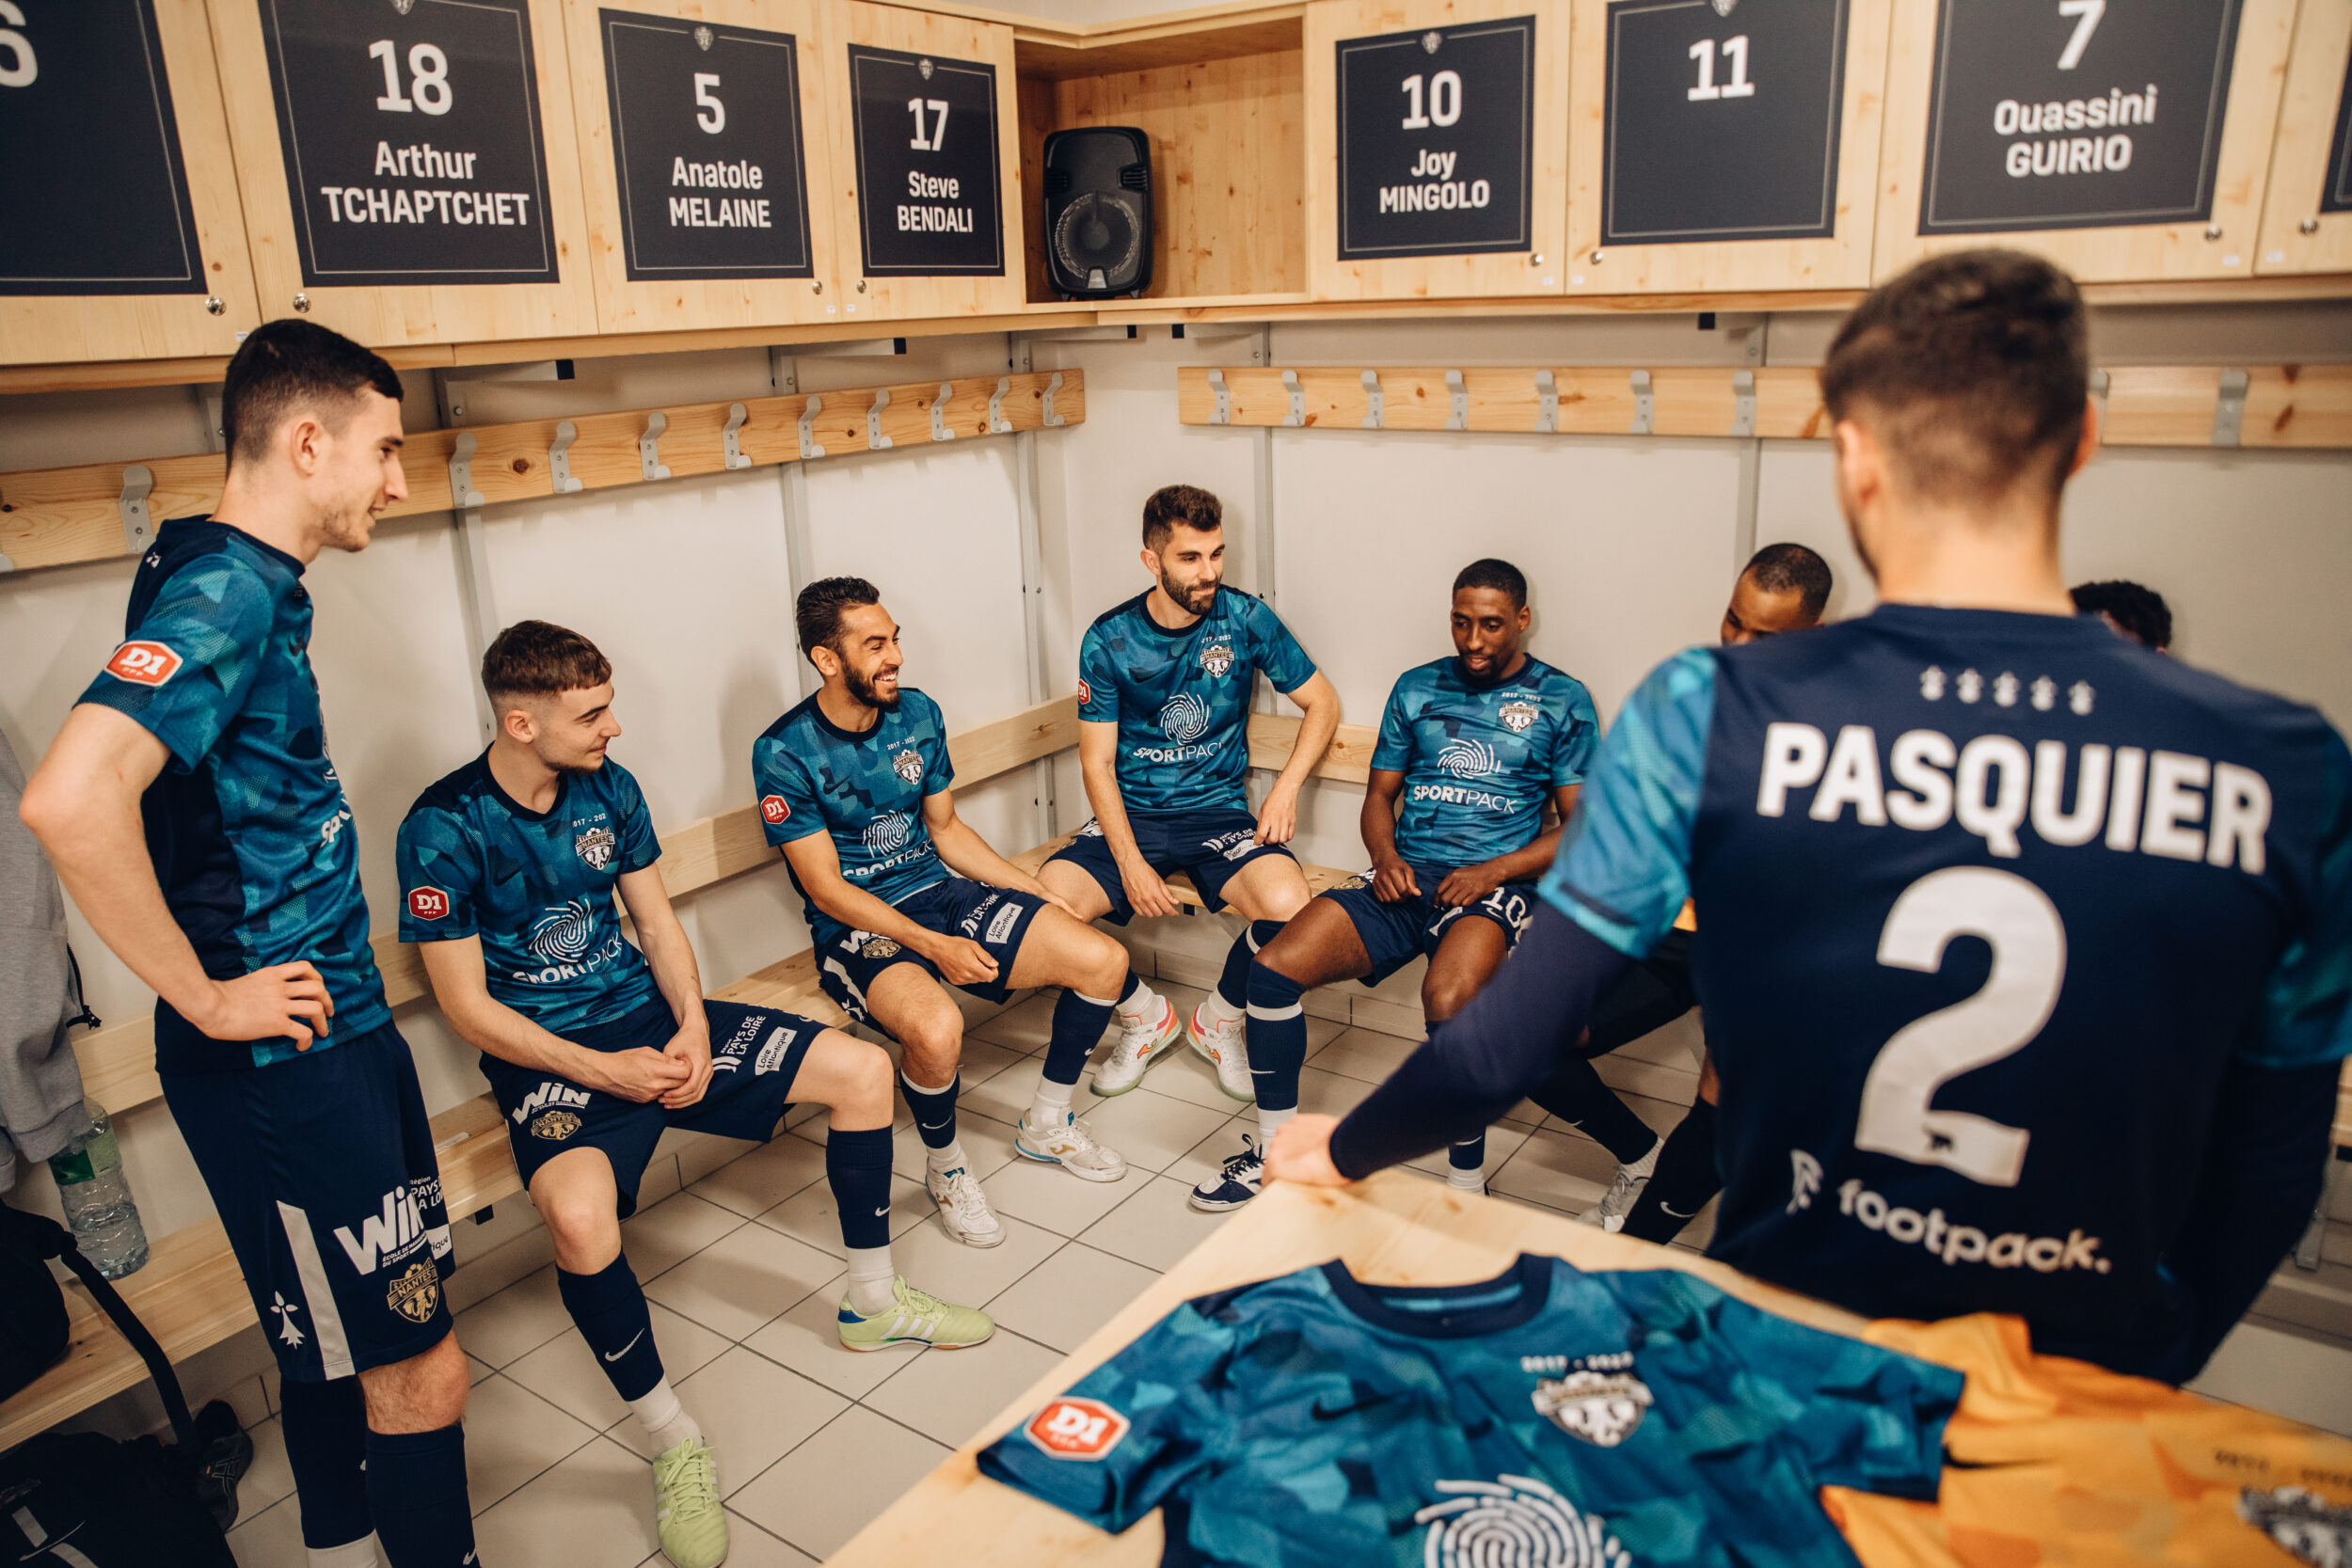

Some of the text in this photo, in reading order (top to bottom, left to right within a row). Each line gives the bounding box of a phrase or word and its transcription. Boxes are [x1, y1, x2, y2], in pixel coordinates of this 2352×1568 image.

[2057, 0, 2106, 71] 7
[369, 40, 453, 116] 18
[1687, 35, 1756, 102] 11
[693, 72, 725, 135] 5
[1402, 70, 1462, 130] 10
[1994, 83, 2158, 135] Ouassini
[908, 98, 949, 151] 17
[374, 141, 477, 180] Arthur
[672, 156, 763, 190] Anatole
[1410, 149, 1457, 181] Joy
[2006, 134, 2133, 178] GUIRIO
[908, 170, 960, 199] Steve
[1379, 179, 1490, 214] MINGOLO
[320, 186, 530, 226] TCHAPTCHET
[668, 197, 772, 229] MELAINE
[897, 205, 973, 232] BENDALI
[120, 647, 167, 675] D1
[1133, 741, 1222, 763] SPORTPAC
[764, 800, 785, 817] D1
[1413, 784, 1518, 815] SPORTPACK
[1756, 721, 2274, 876] PASQUIER
[416, 894, 442, 911] D1
[988, 920, 1001, 937] Loire
[995, 907, 1016, 940] Atlantique
[726, 1030, 746, 1054] PAYS
[741, 1015, 755, 1029] DE
[736, 1015, 767, 1055] LA LOIRE
[1853, 864, 2069, 1188] 2
[757, 1049, 771, 1069] Loire
[766, 1031, 788, 1069] Atlantique
[411, 1179, 438, 1200] PAYS
[1837, 1177, 2111, 1275] footpack.
[397, 1270, 432, 1298] NANTES
[1045, 1404, 1108, 1445] D1
